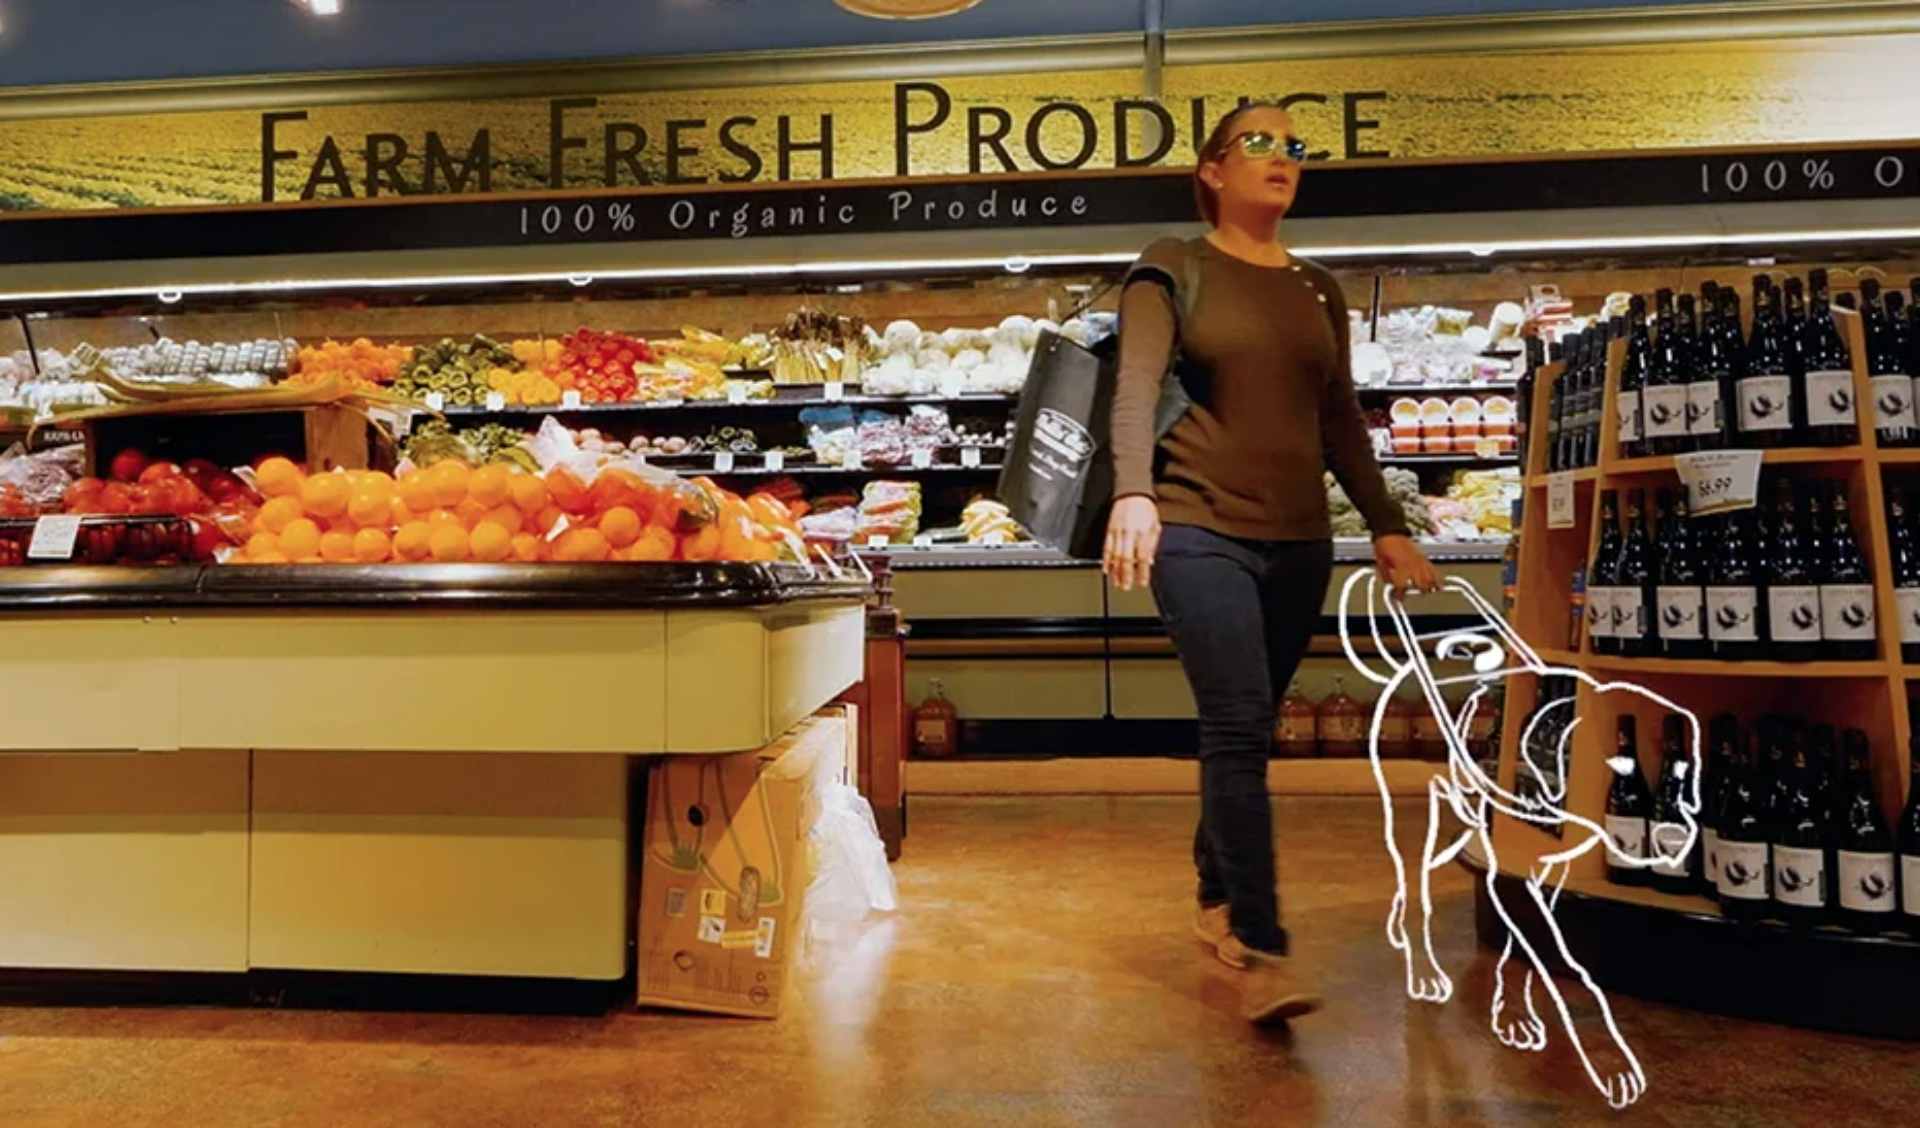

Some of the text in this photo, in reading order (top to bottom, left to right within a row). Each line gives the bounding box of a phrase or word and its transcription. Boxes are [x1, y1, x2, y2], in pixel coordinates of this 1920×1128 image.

[262, 111, 490, 202] FARM
[550, 97, 833, 188] FRESH
[1700, 159, 1835, 193] 100%
[520, 189, 1087, 238] 100% Organic Produce
